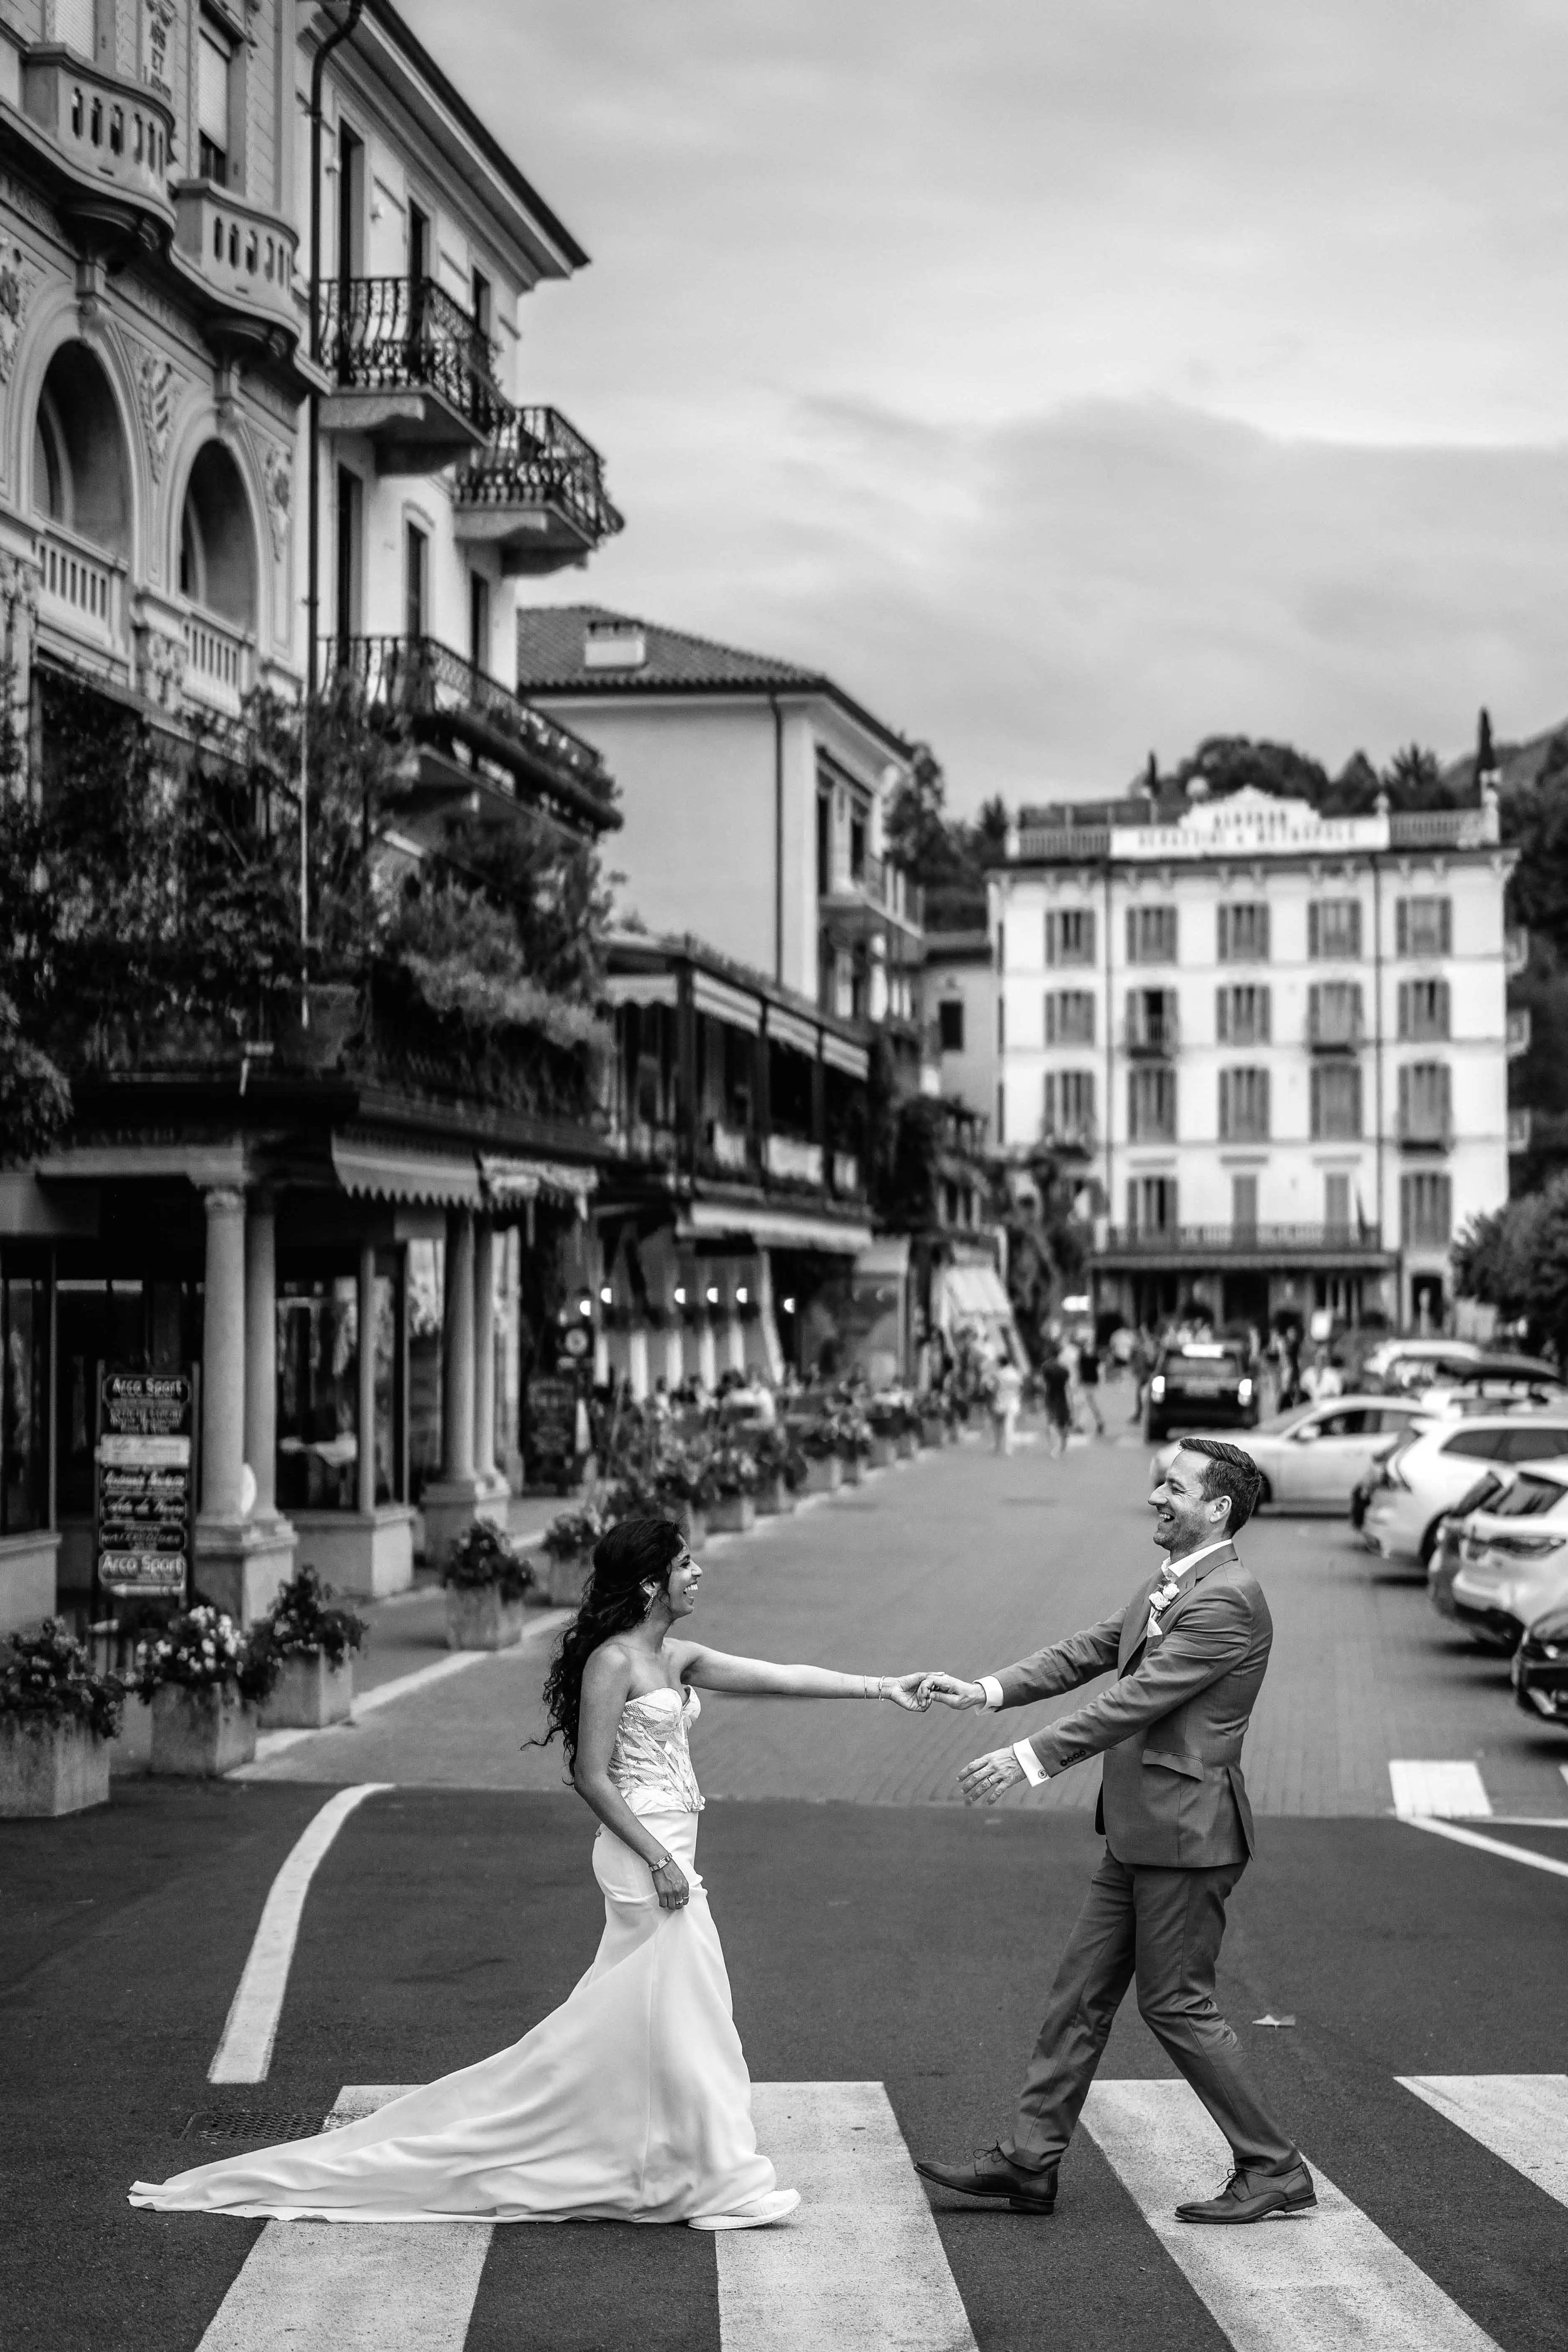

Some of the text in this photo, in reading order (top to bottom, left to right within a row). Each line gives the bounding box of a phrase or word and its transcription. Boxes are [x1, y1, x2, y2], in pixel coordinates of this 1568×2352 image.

[112, 1377, 182, 1397] Arco Sport
[102, 1554, 183, 1577] Arco Sport
